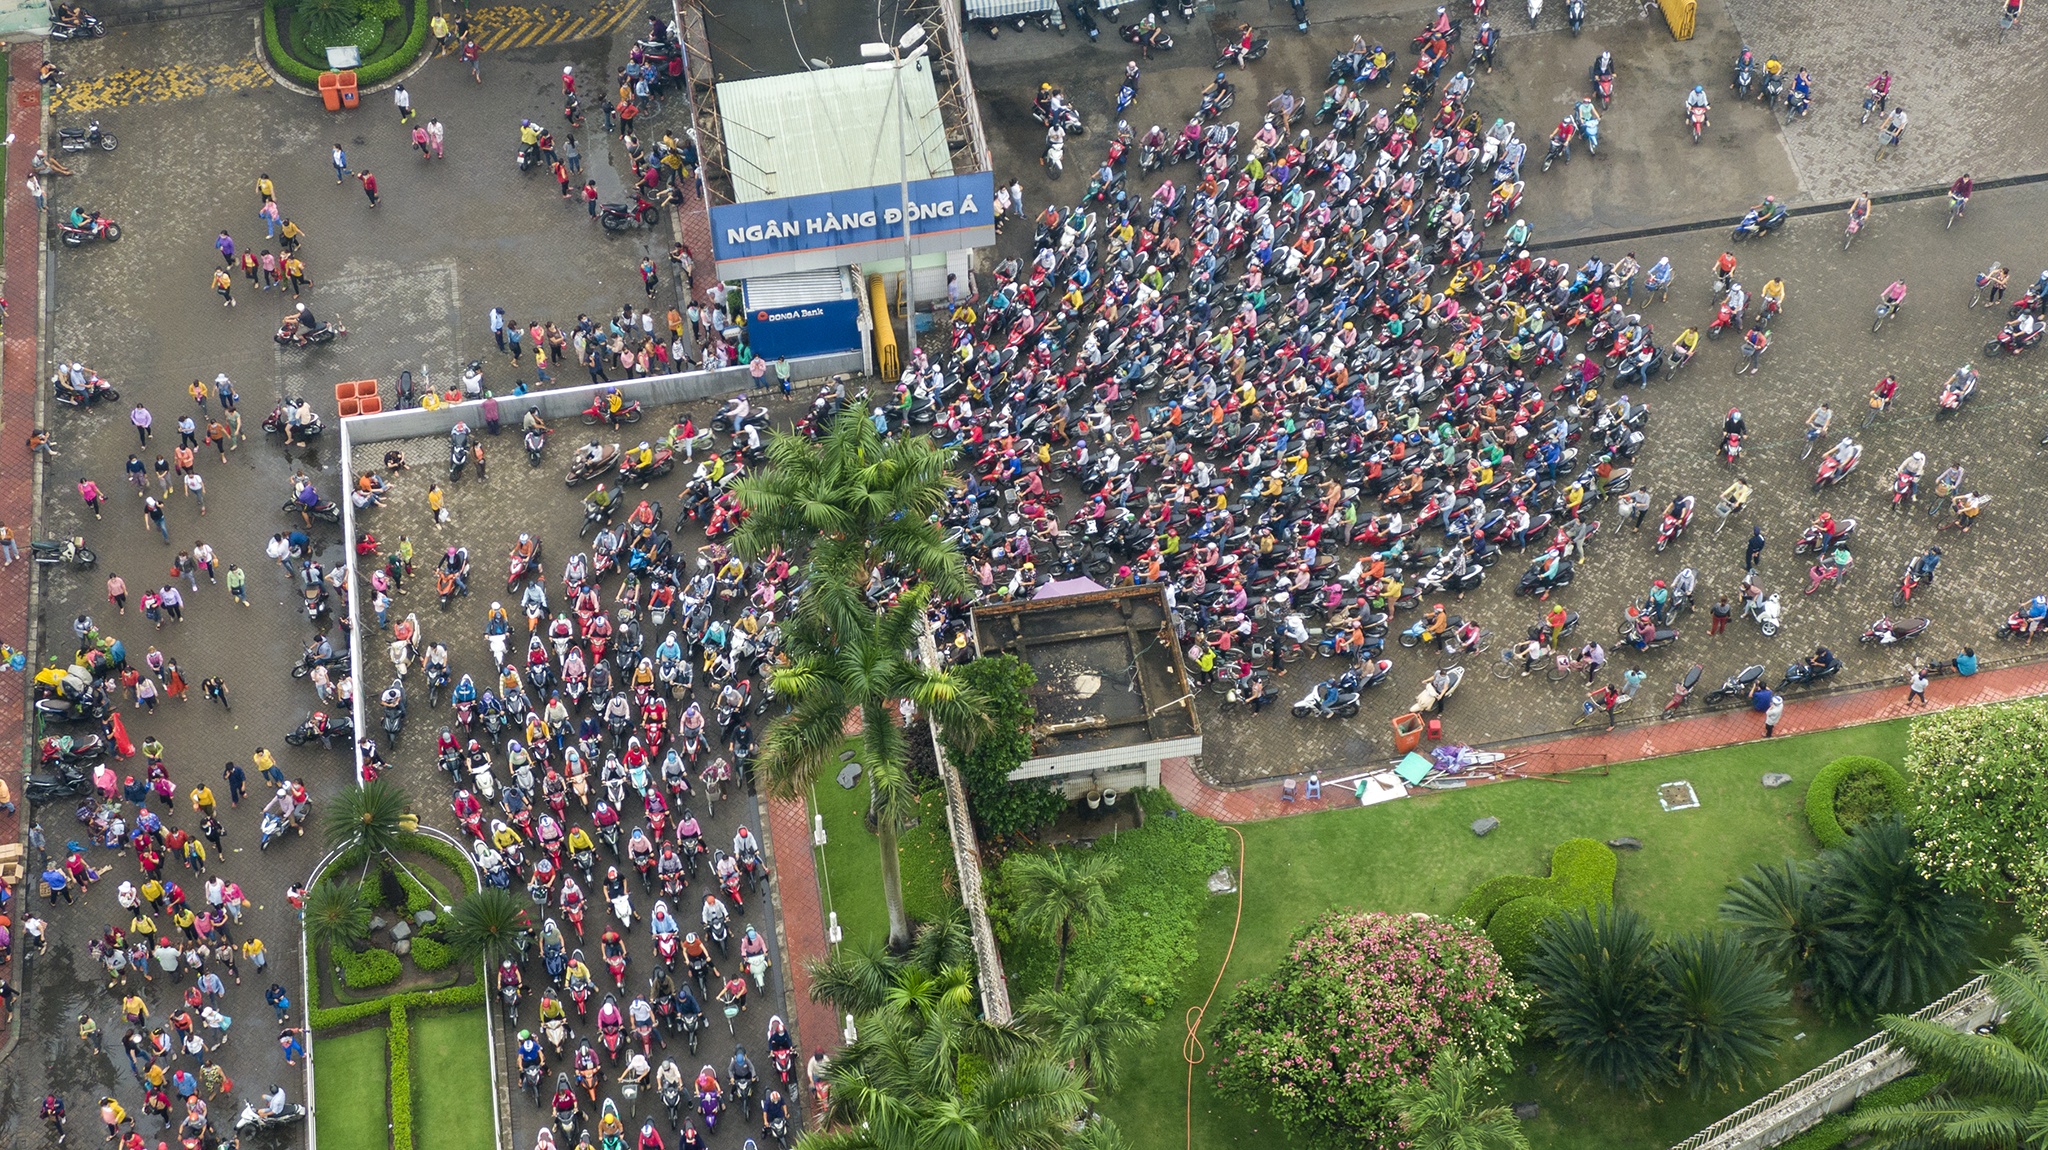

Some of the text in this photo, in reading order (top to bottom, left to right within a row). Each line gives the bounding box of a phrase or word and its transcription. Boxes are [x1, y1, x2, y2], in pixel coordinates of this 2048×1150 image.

[727, 194, 978, 245] NGÂN HÀNG ĐÔNG Á
[801, 308, 824, 318] Bank
